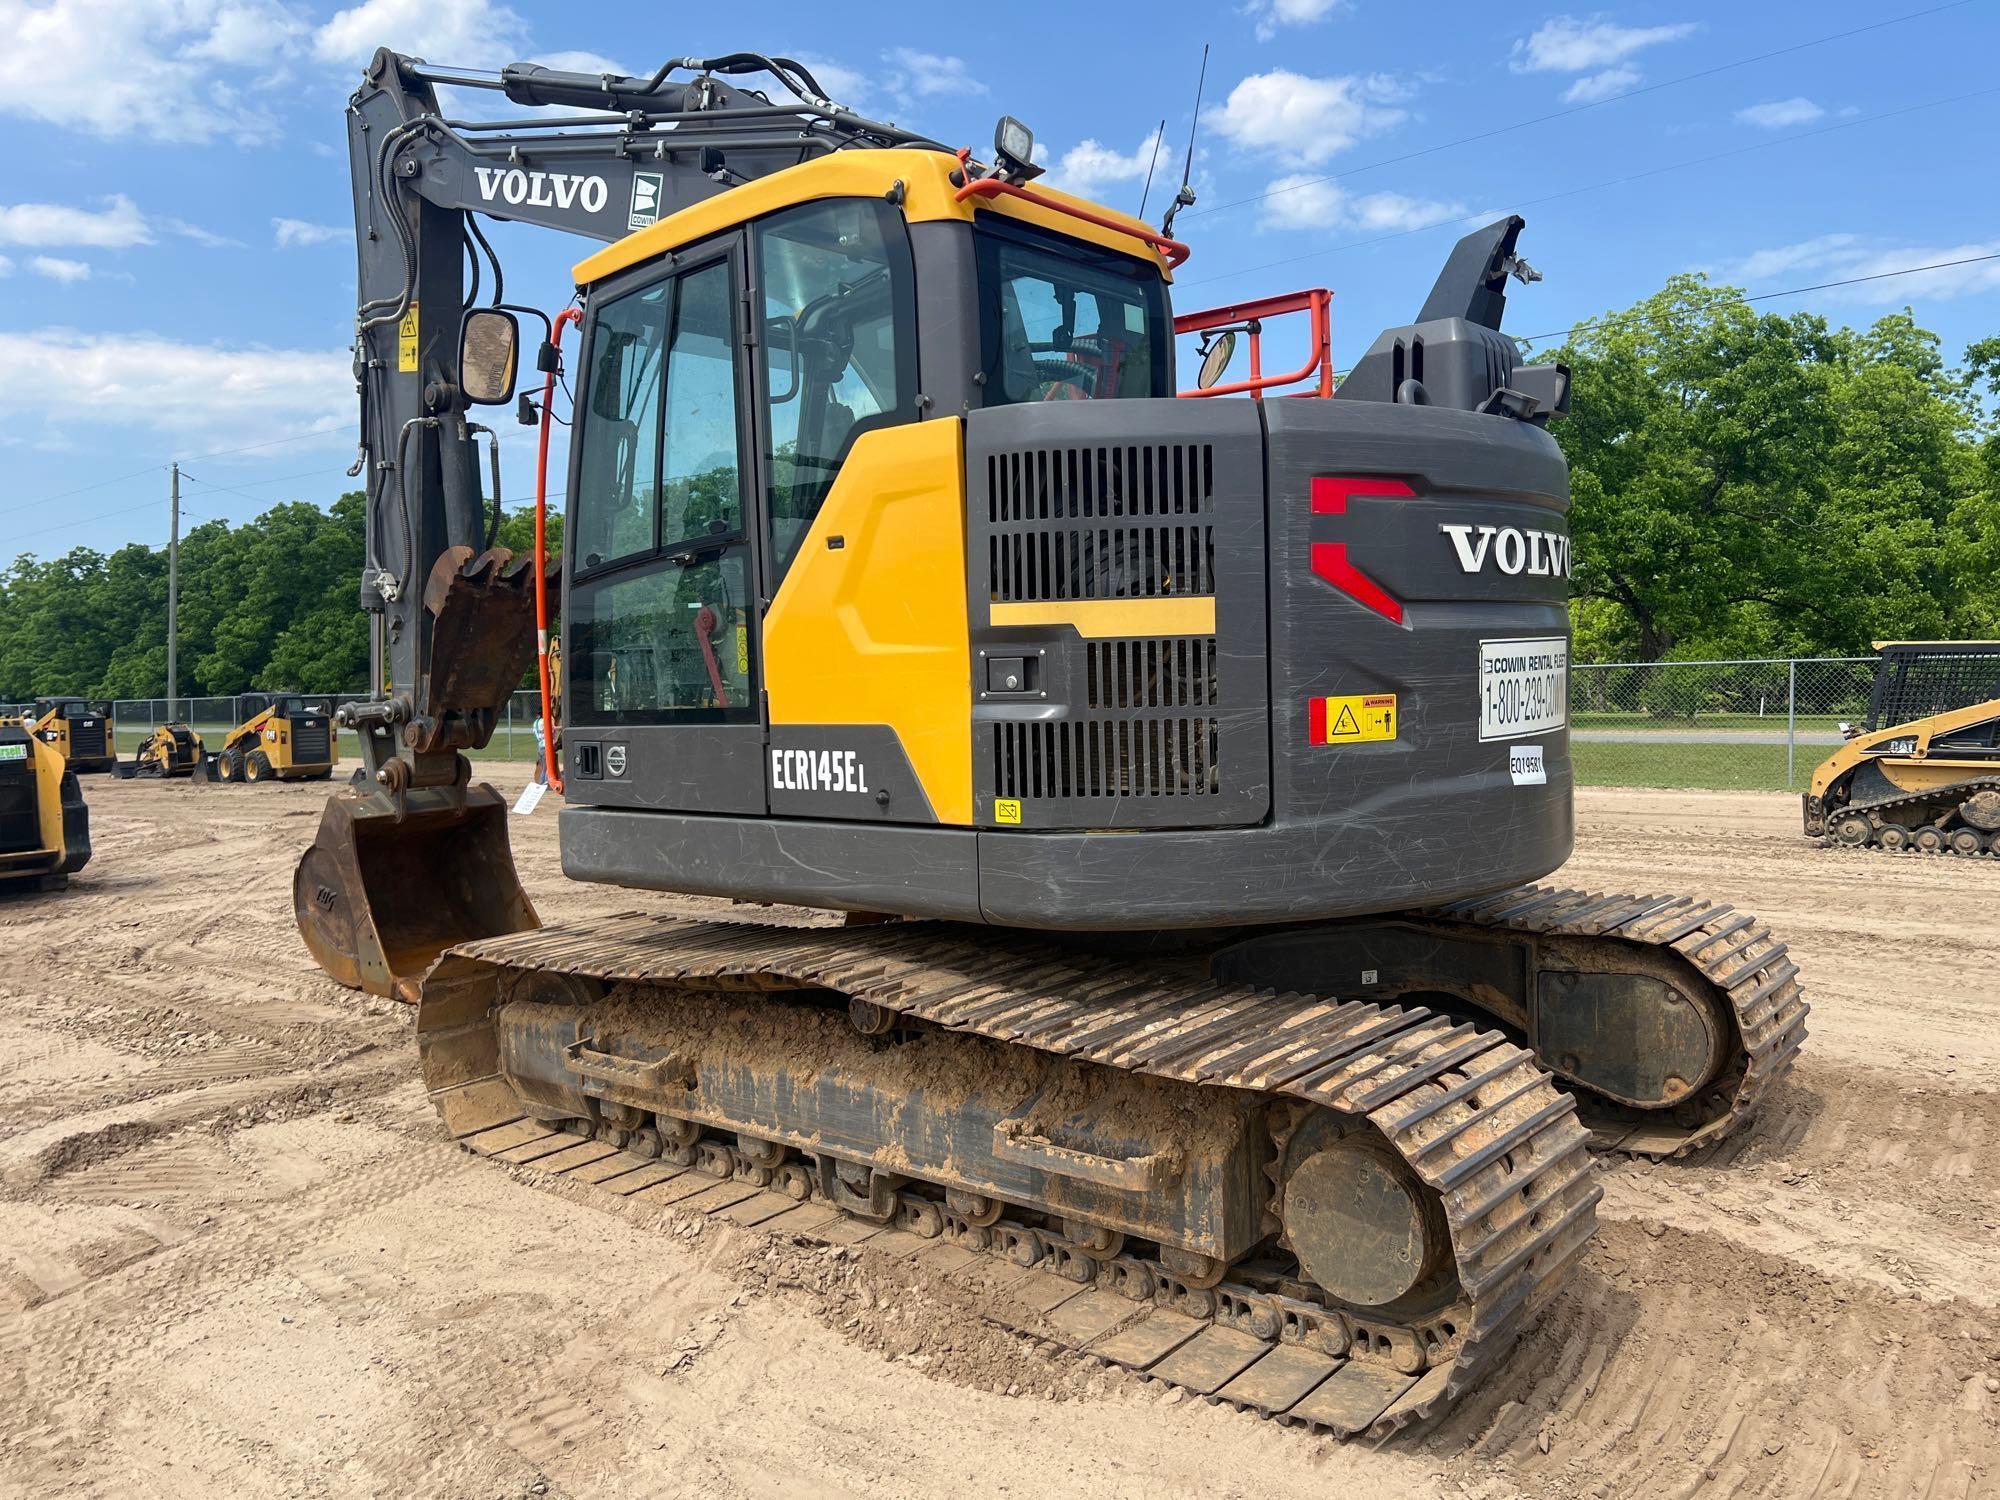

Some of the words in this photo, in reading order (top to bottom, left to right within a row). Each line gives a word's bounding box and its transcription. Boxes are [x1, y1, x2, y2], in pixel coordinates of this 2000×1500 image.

[474, 167, 608, 213] VOLVO
[1441, 525, 1571, 579] VOLVO
[1494, 656, 1526, 674] COWIN
[1528, 654, 1553, 672] RENTAL
[1510, 757, 1543, 774] EQ19581
